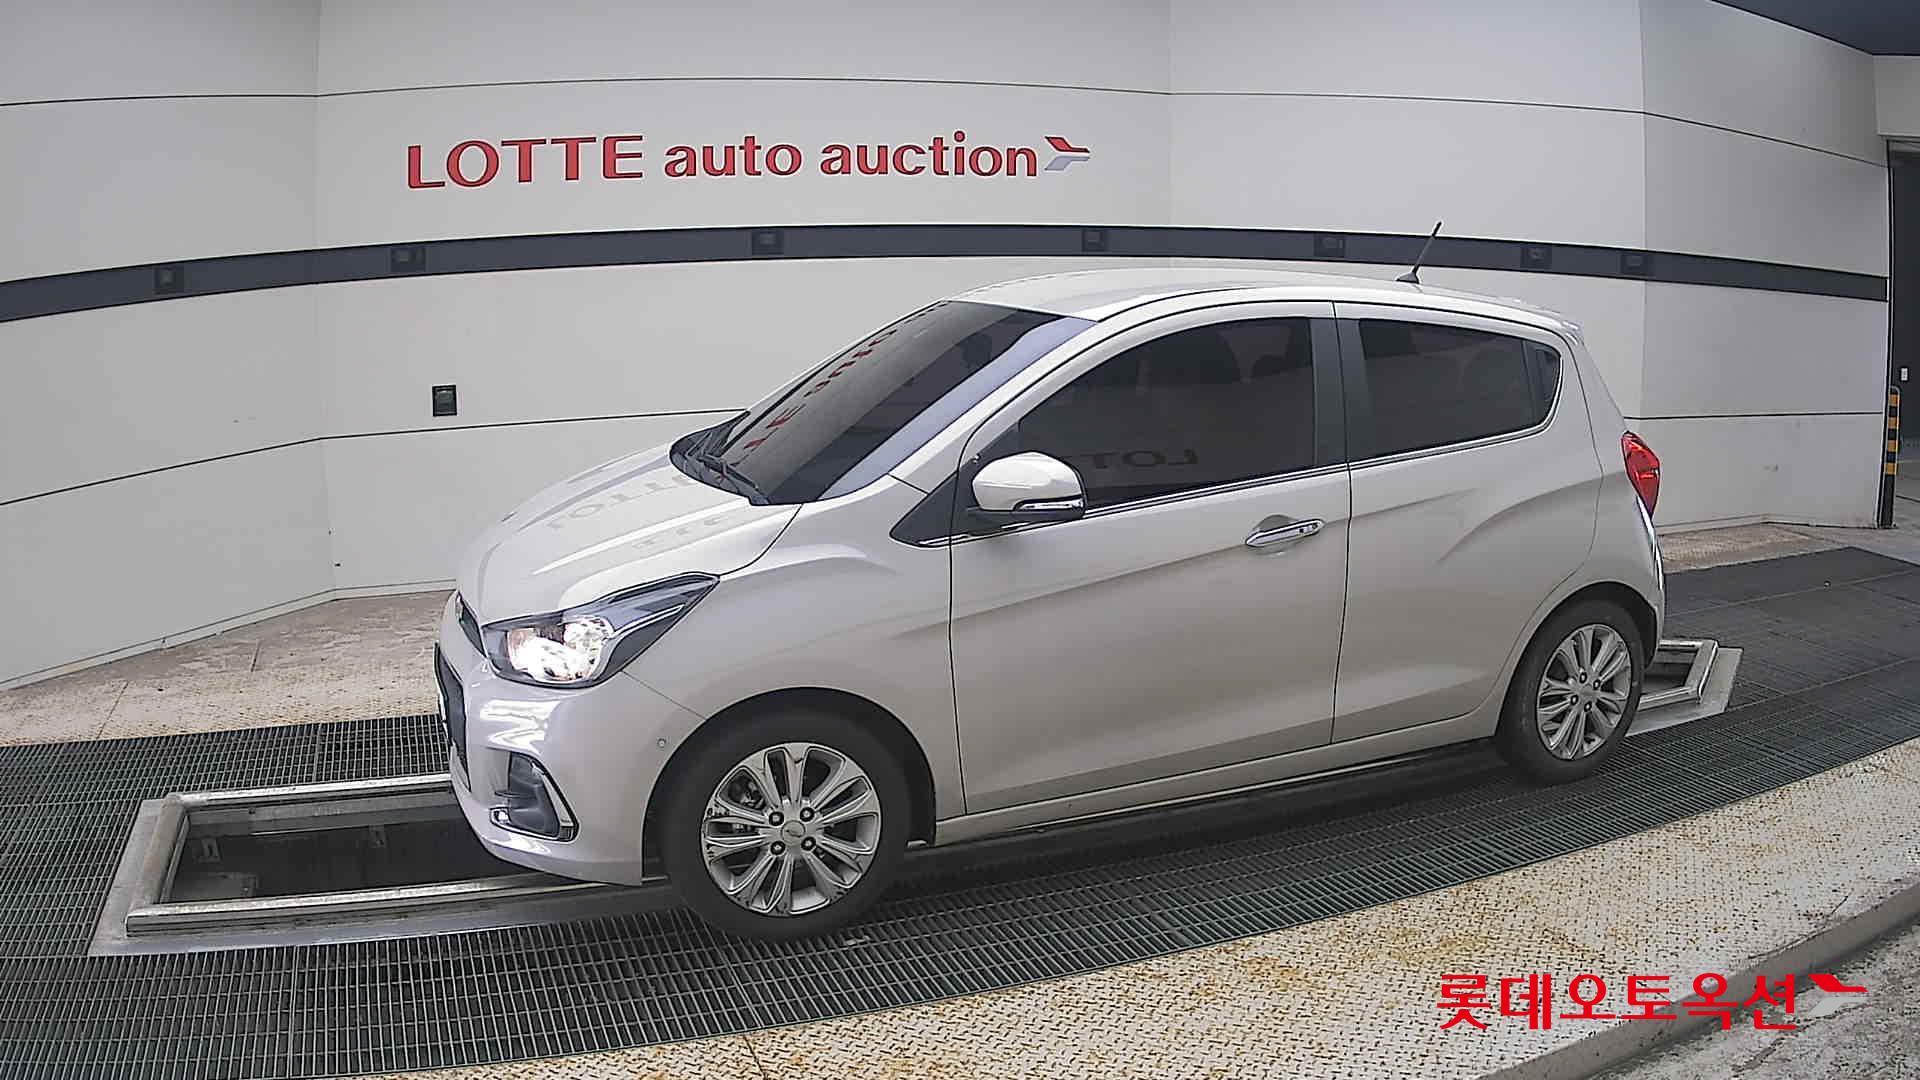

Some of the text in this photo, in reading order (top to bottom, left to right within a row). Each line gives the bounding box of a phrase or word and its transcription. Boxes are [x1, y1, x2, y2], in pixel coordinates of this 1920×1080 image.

[407, 131, 1038, 189] LOTTE auto auction
